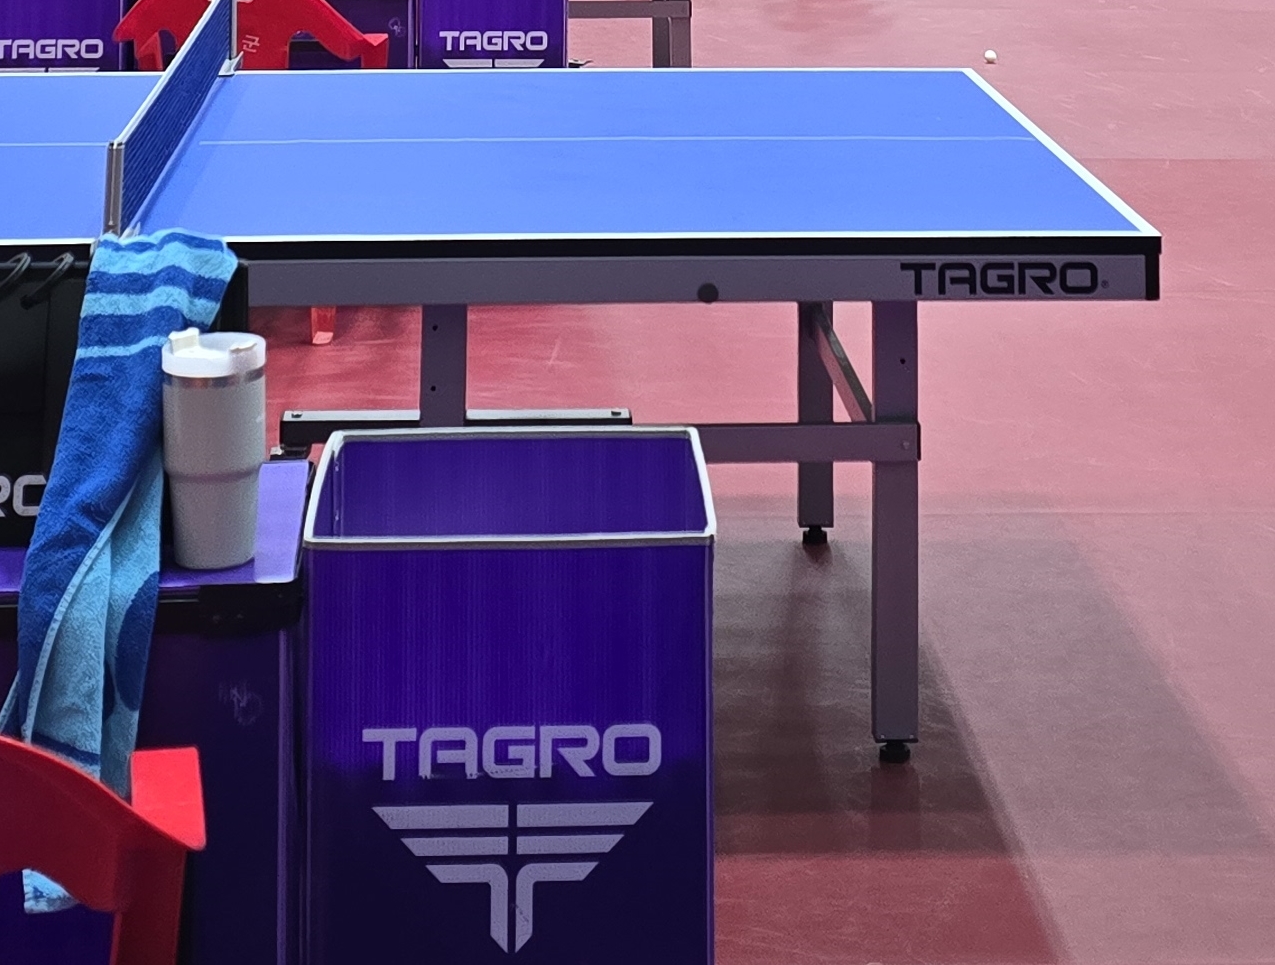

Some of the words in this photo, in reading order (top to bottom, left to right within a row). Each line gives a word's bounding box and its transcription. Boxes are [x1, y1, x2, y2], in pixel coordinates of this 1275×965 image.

[439, 30, 548, 51] TAGRO
[900, 262, 1099, 296] TAGRO
[362, 723, 662, 781] TAGRO
